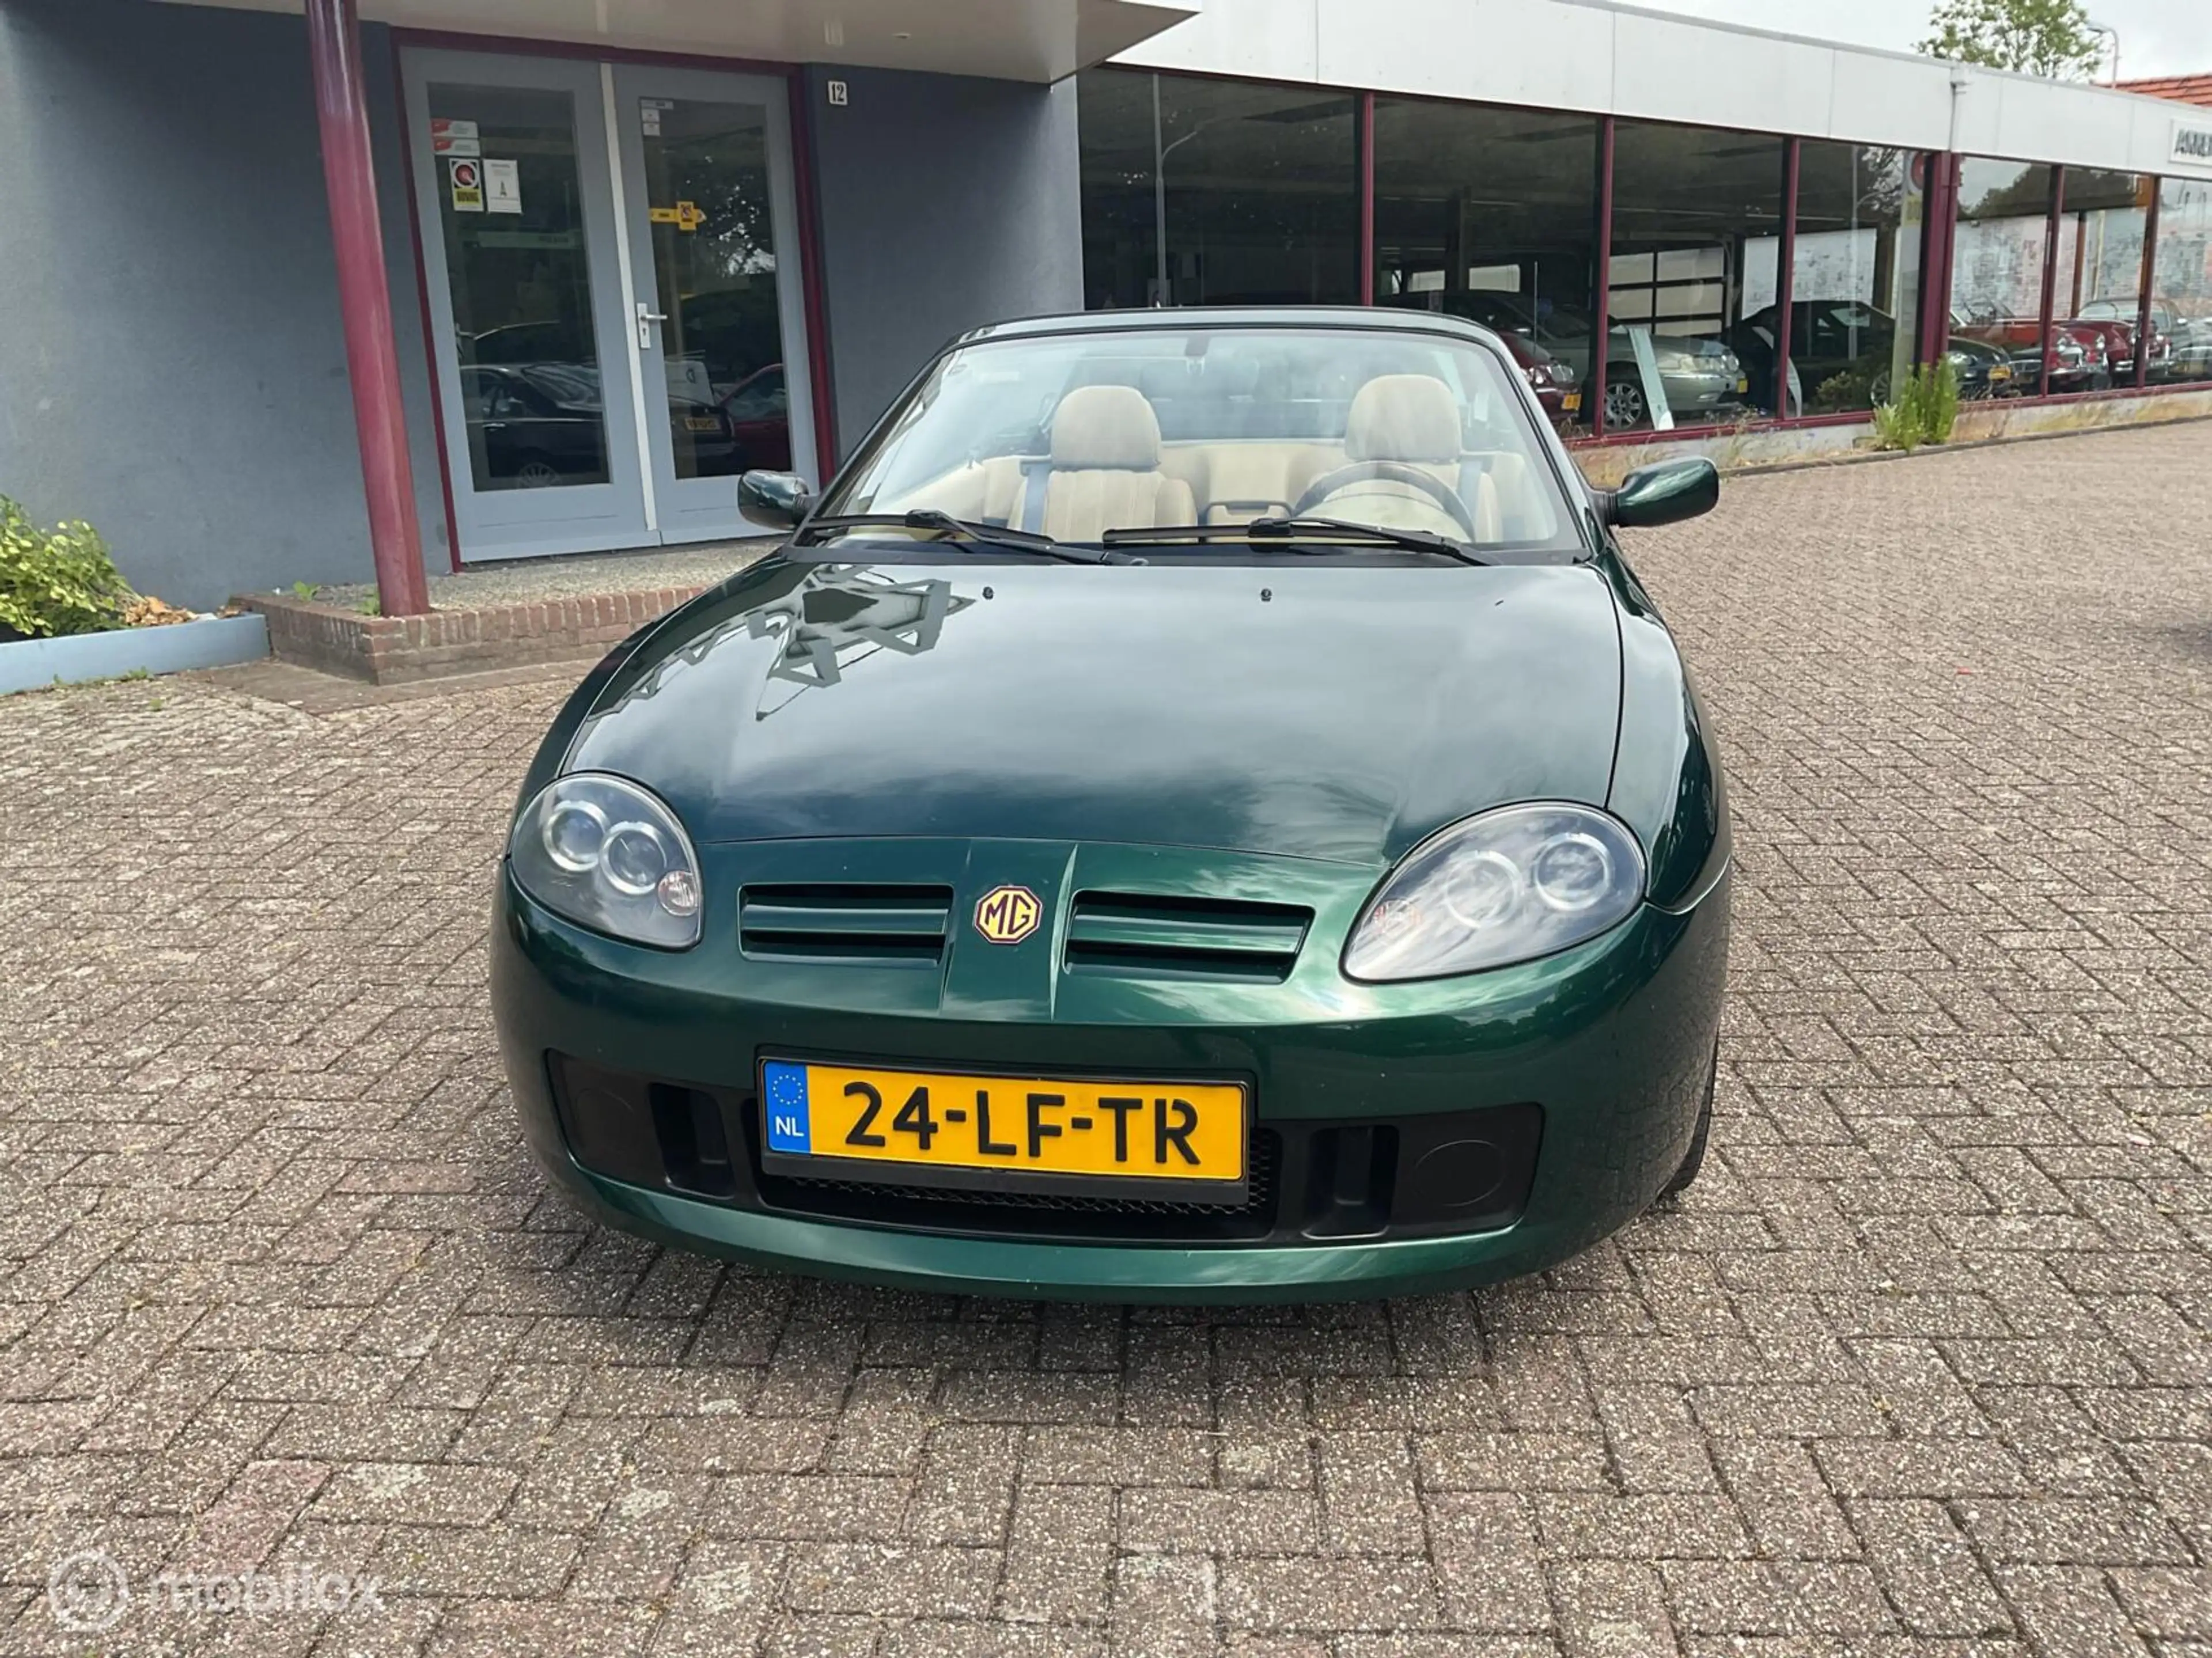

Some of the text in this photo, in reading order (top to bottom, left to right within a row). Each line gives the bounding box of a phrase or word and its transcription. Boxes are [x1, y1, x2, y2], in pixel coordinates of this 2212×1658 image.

[831, 83, 844, 102] 12
[984, 893, 1032, 935] MG
[775, 1116, 805, 1137] NL
[844, 1082, 1201, 1165] 24-LF-TR
